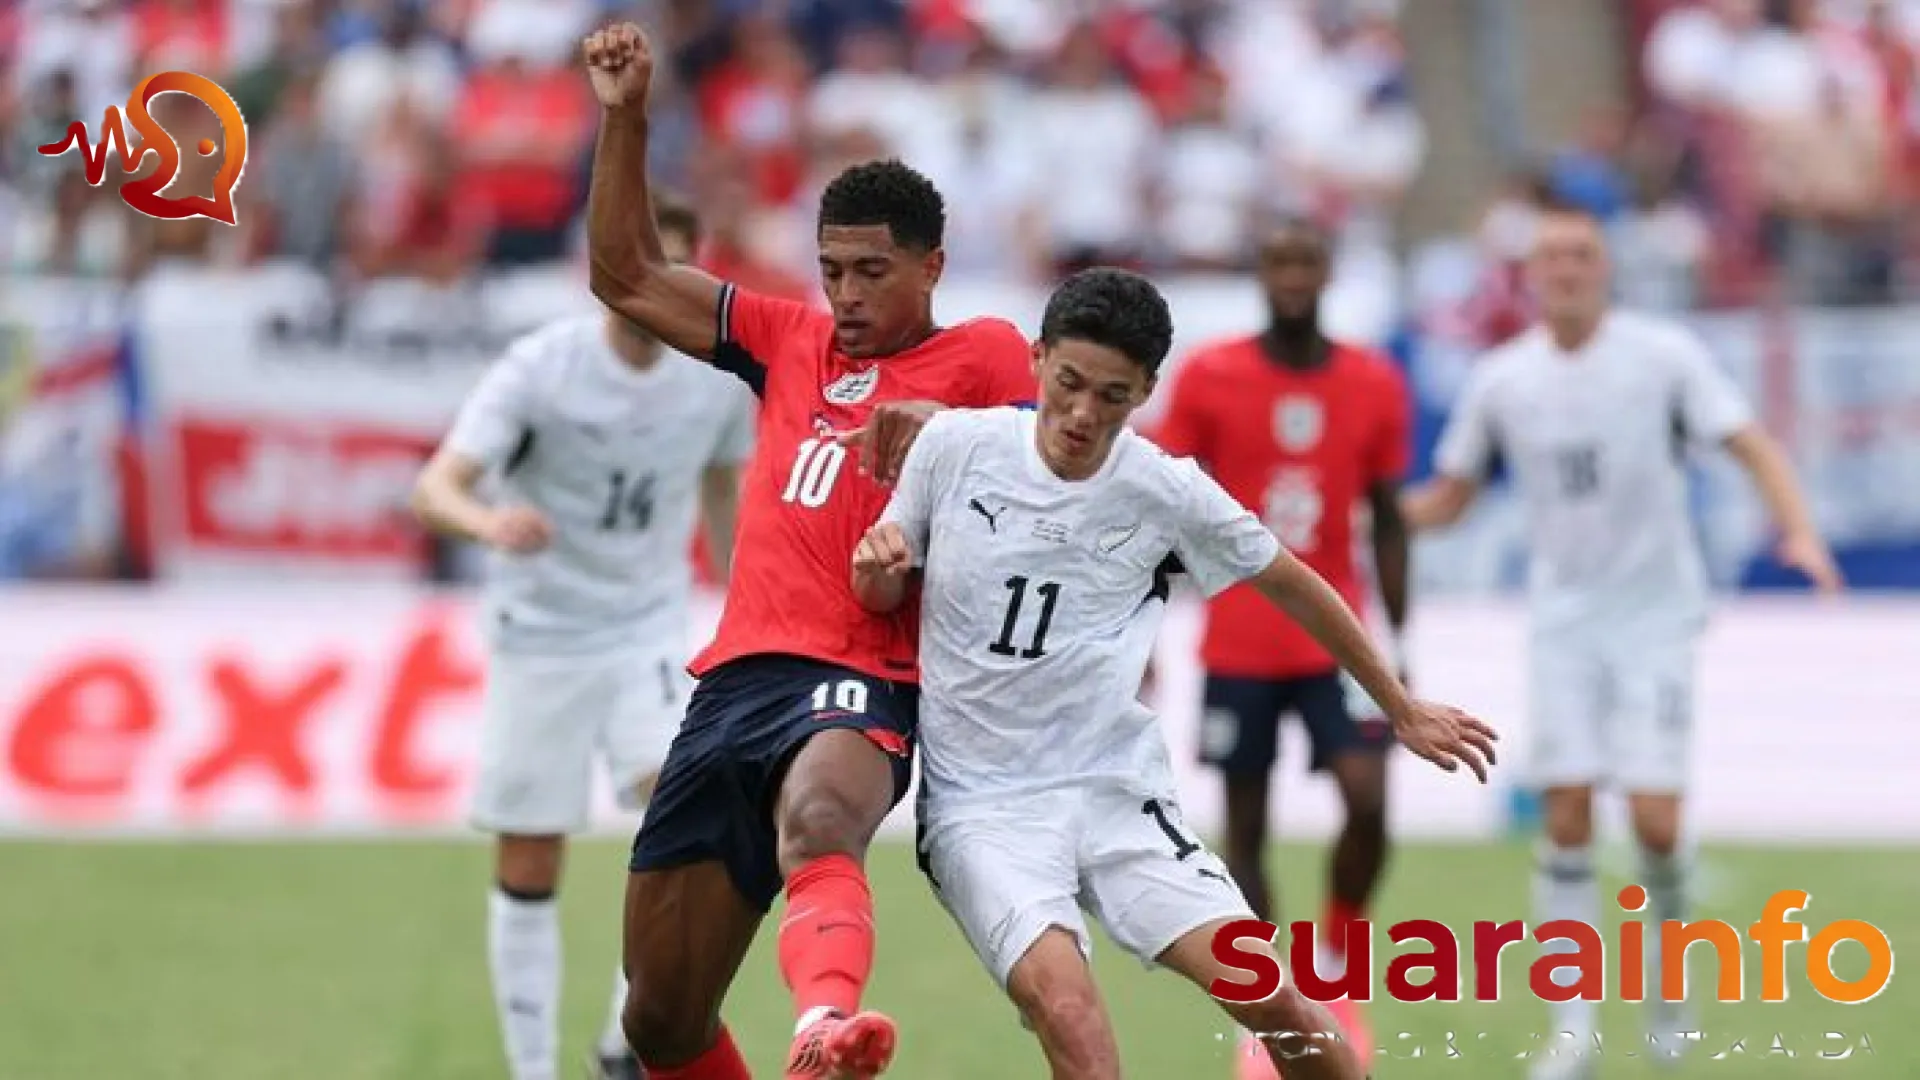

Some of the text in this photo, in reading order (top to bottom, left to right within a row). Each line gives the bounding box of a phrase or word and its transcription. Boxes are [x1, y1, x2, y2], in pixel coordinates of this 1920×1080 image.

[597, 470, 654, 533] 14
[781, 438, 846, 508] 10
[988, 575, 1062, 659] 11
[811, 680, 867, 713] 10
